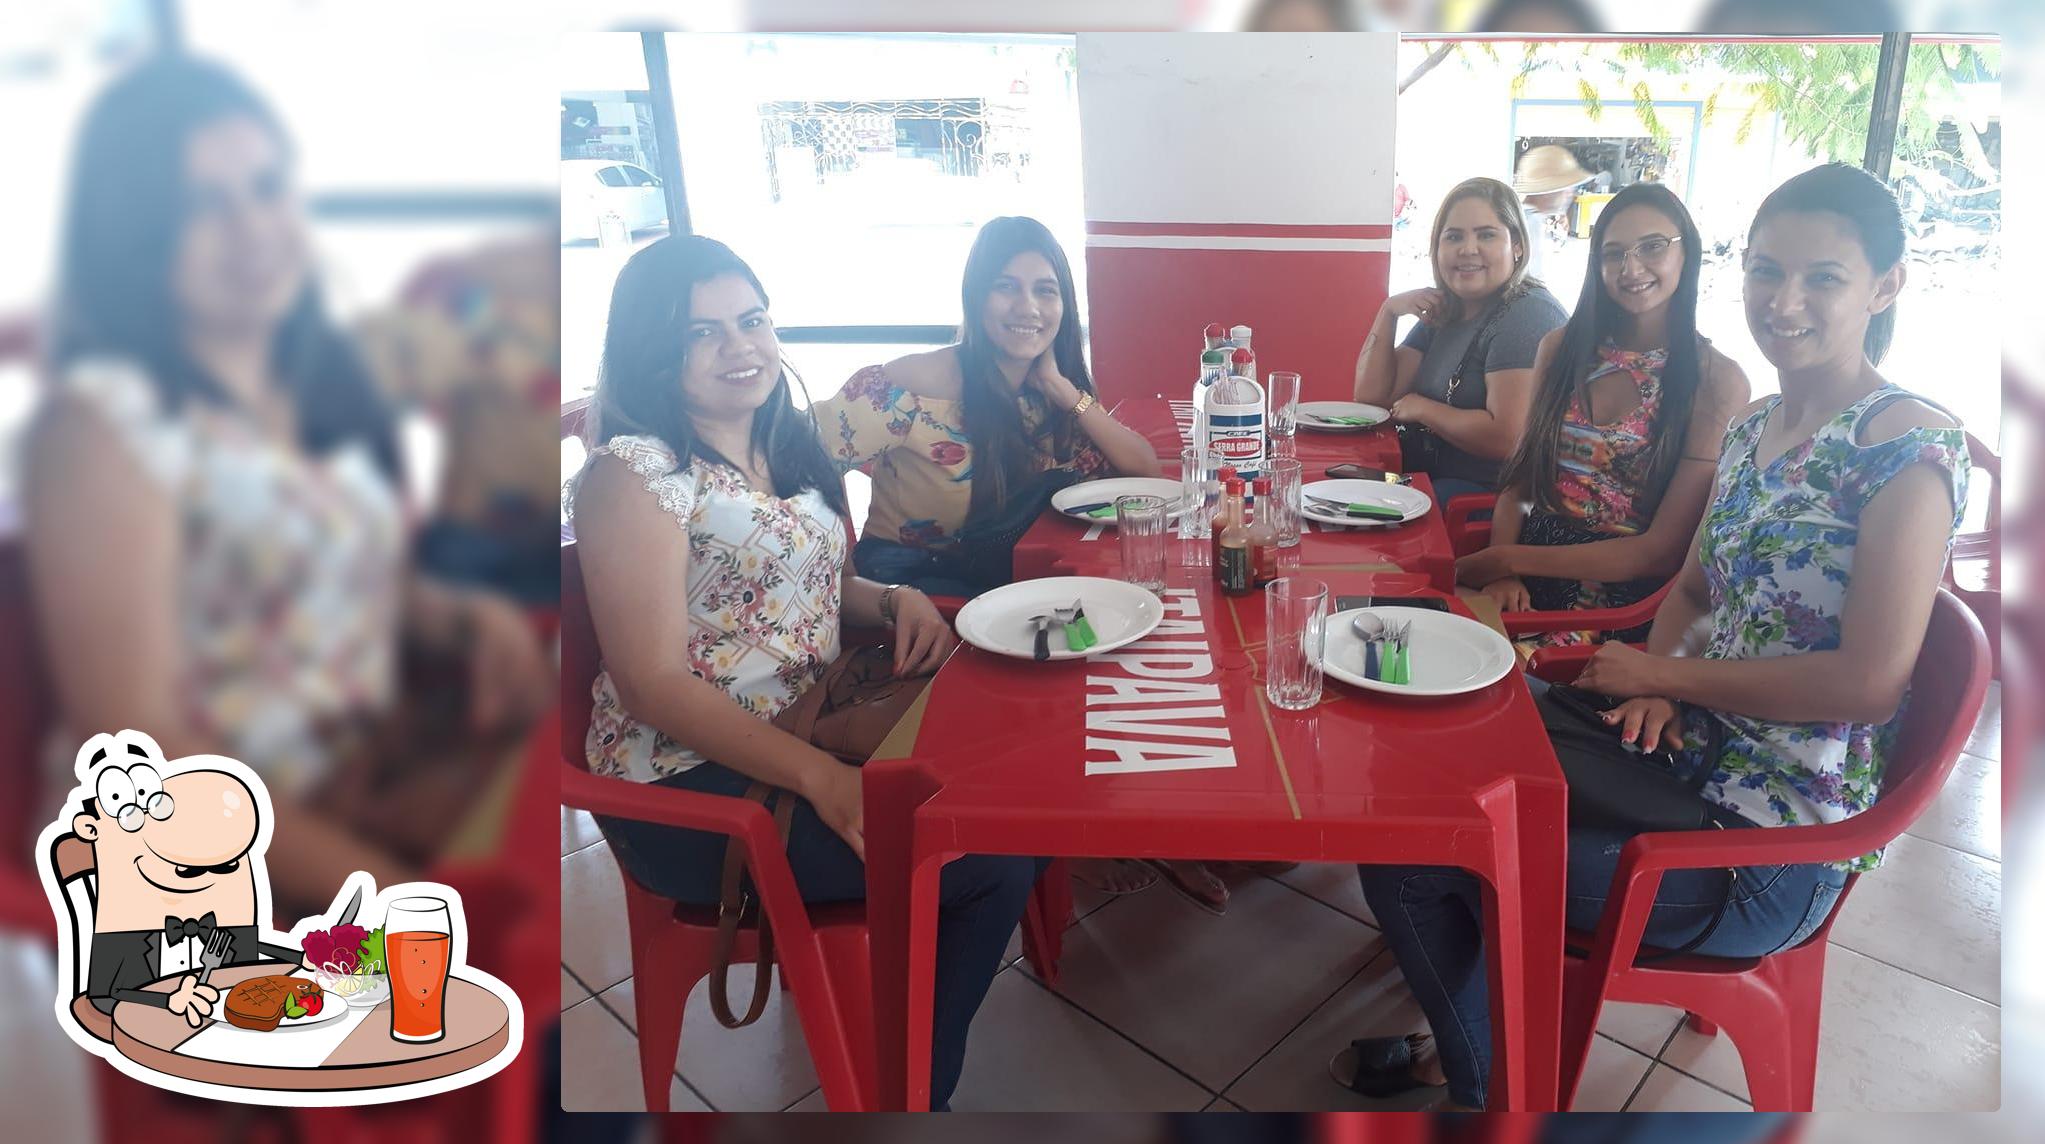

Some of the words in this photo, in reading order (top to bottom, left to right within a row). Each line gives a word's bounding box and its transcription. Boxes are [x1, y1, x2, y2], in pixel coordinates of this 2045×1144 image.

[1214, 442, 1235, 452] SERRA
[1236, 442, 1260, 452] GRANDE
[1084, 587, 1238, 777] IPAVA
